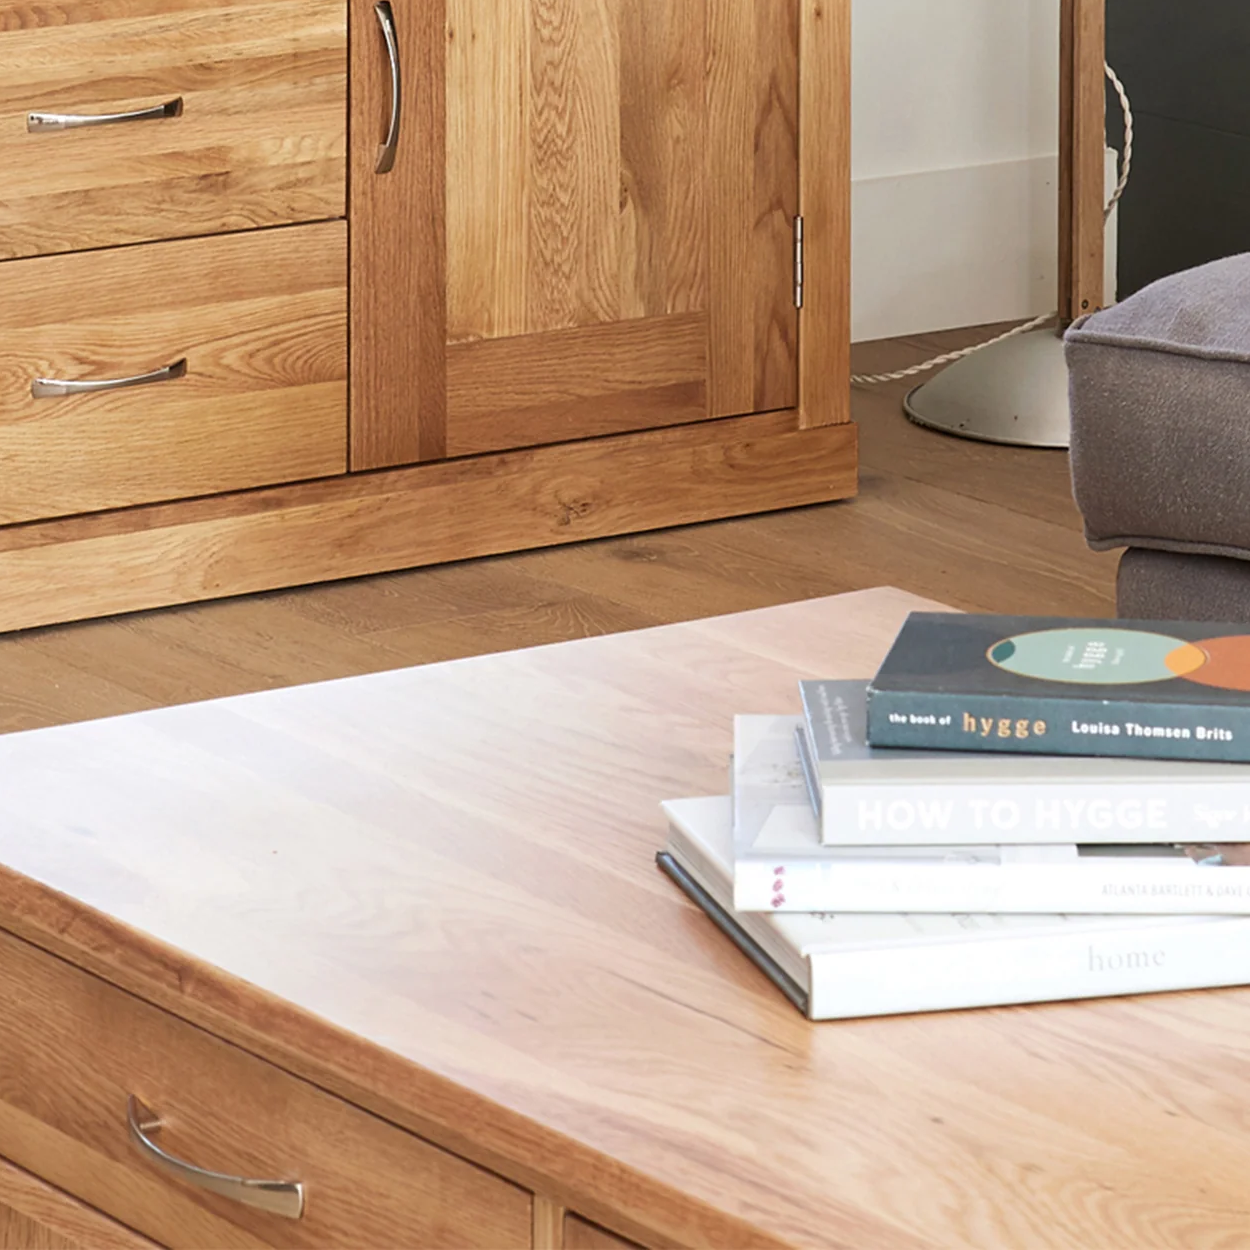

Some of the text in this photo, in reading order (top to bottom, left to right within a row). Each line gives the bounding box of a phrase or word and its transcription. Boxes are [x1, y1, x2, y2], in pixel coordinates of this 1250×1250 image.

[888, 712, 1047, 738] the book of hygge
[1071, 720, 1233, 741] Louisa Thomsen Brits
[857, 799, 953, 831] HOW
[968, 799, 1030, 830] TO
[1035, 799, 1168, 830] HYGGE
[1101, 883, 1148, 896] ATLANTA
[1150, 884, 1203, 897] BARTLETT
[1087, 944, 1166, 972] home
